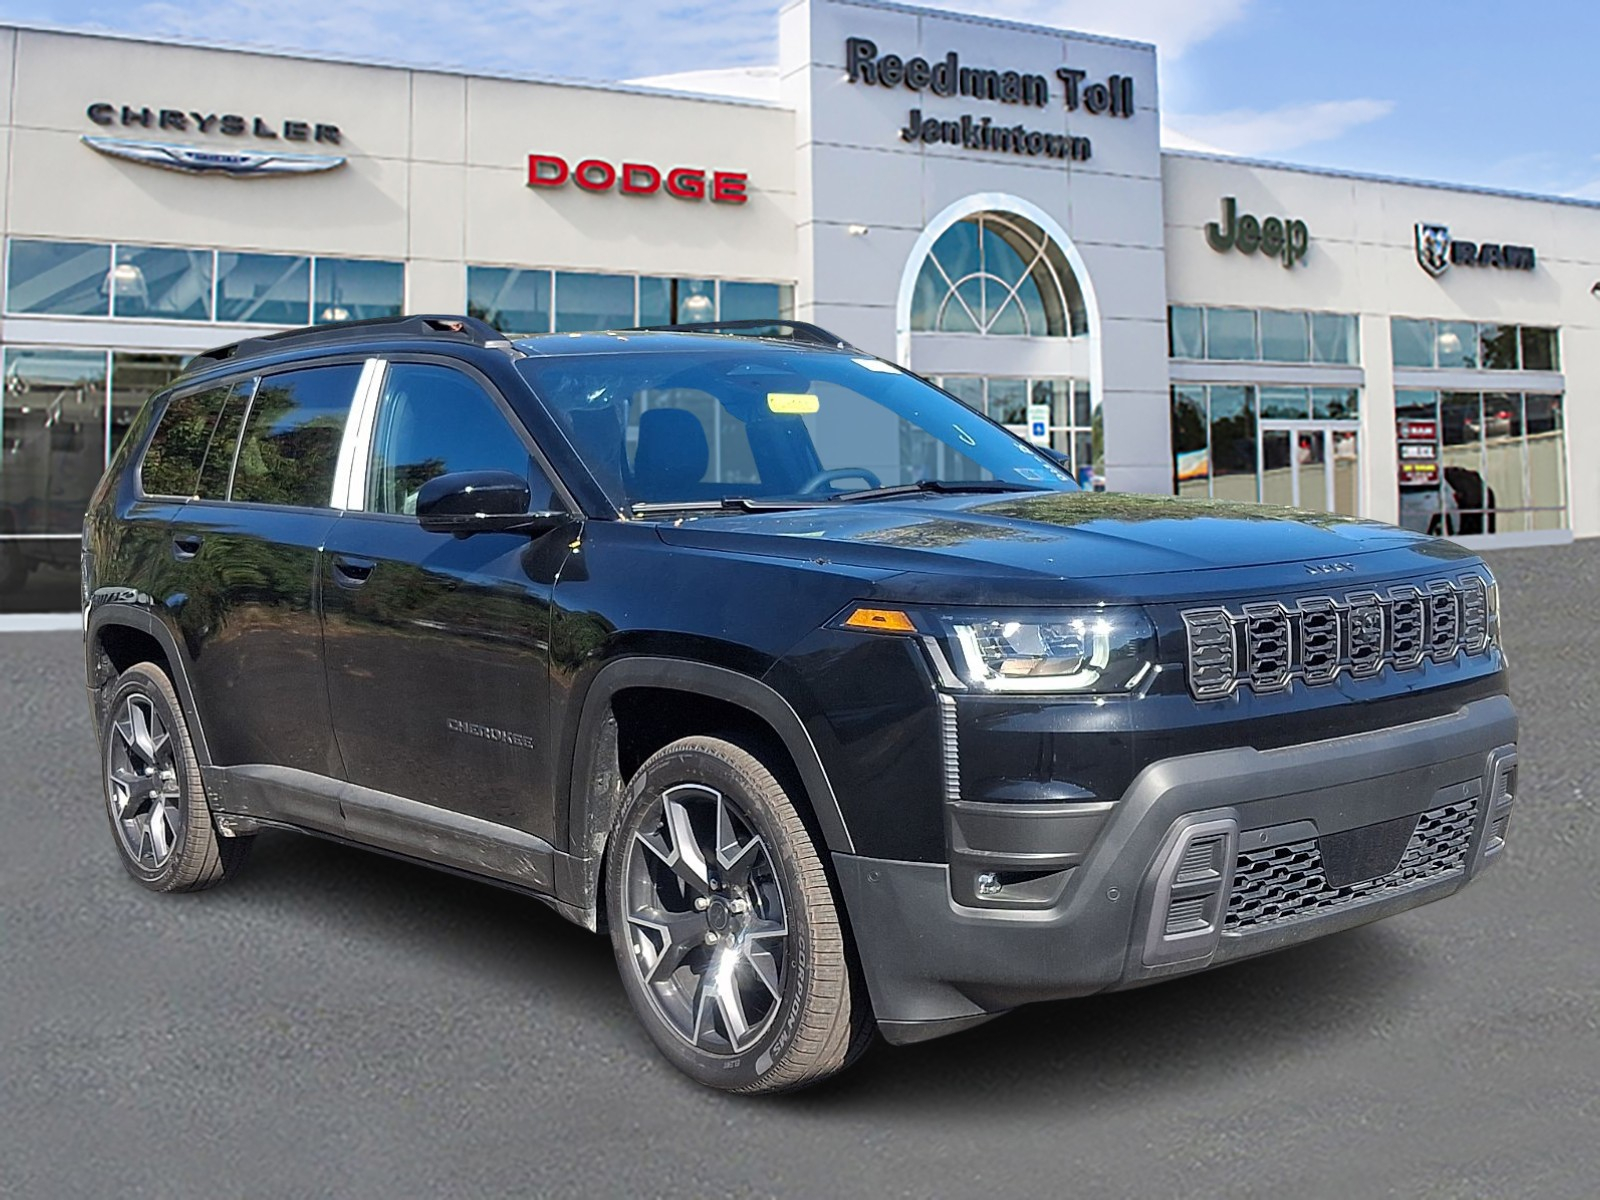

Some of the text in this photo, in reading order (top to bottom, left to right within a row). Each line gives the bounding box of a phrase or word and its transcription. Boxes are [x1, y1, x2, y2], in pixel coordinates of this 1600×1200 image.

[846, 37, 1135, 119] Reedman Toll
[87, 103, 341, 145] CHRYSLER
[902, 109, 1091, 161] Jenkintown
[527, 154, 748, 204] DODGE
[1205, 197, 1308, 268] Jeep
[1451, 240, 1535, 270] RAM
[446, 718, 534, 749] CHEROKEE
